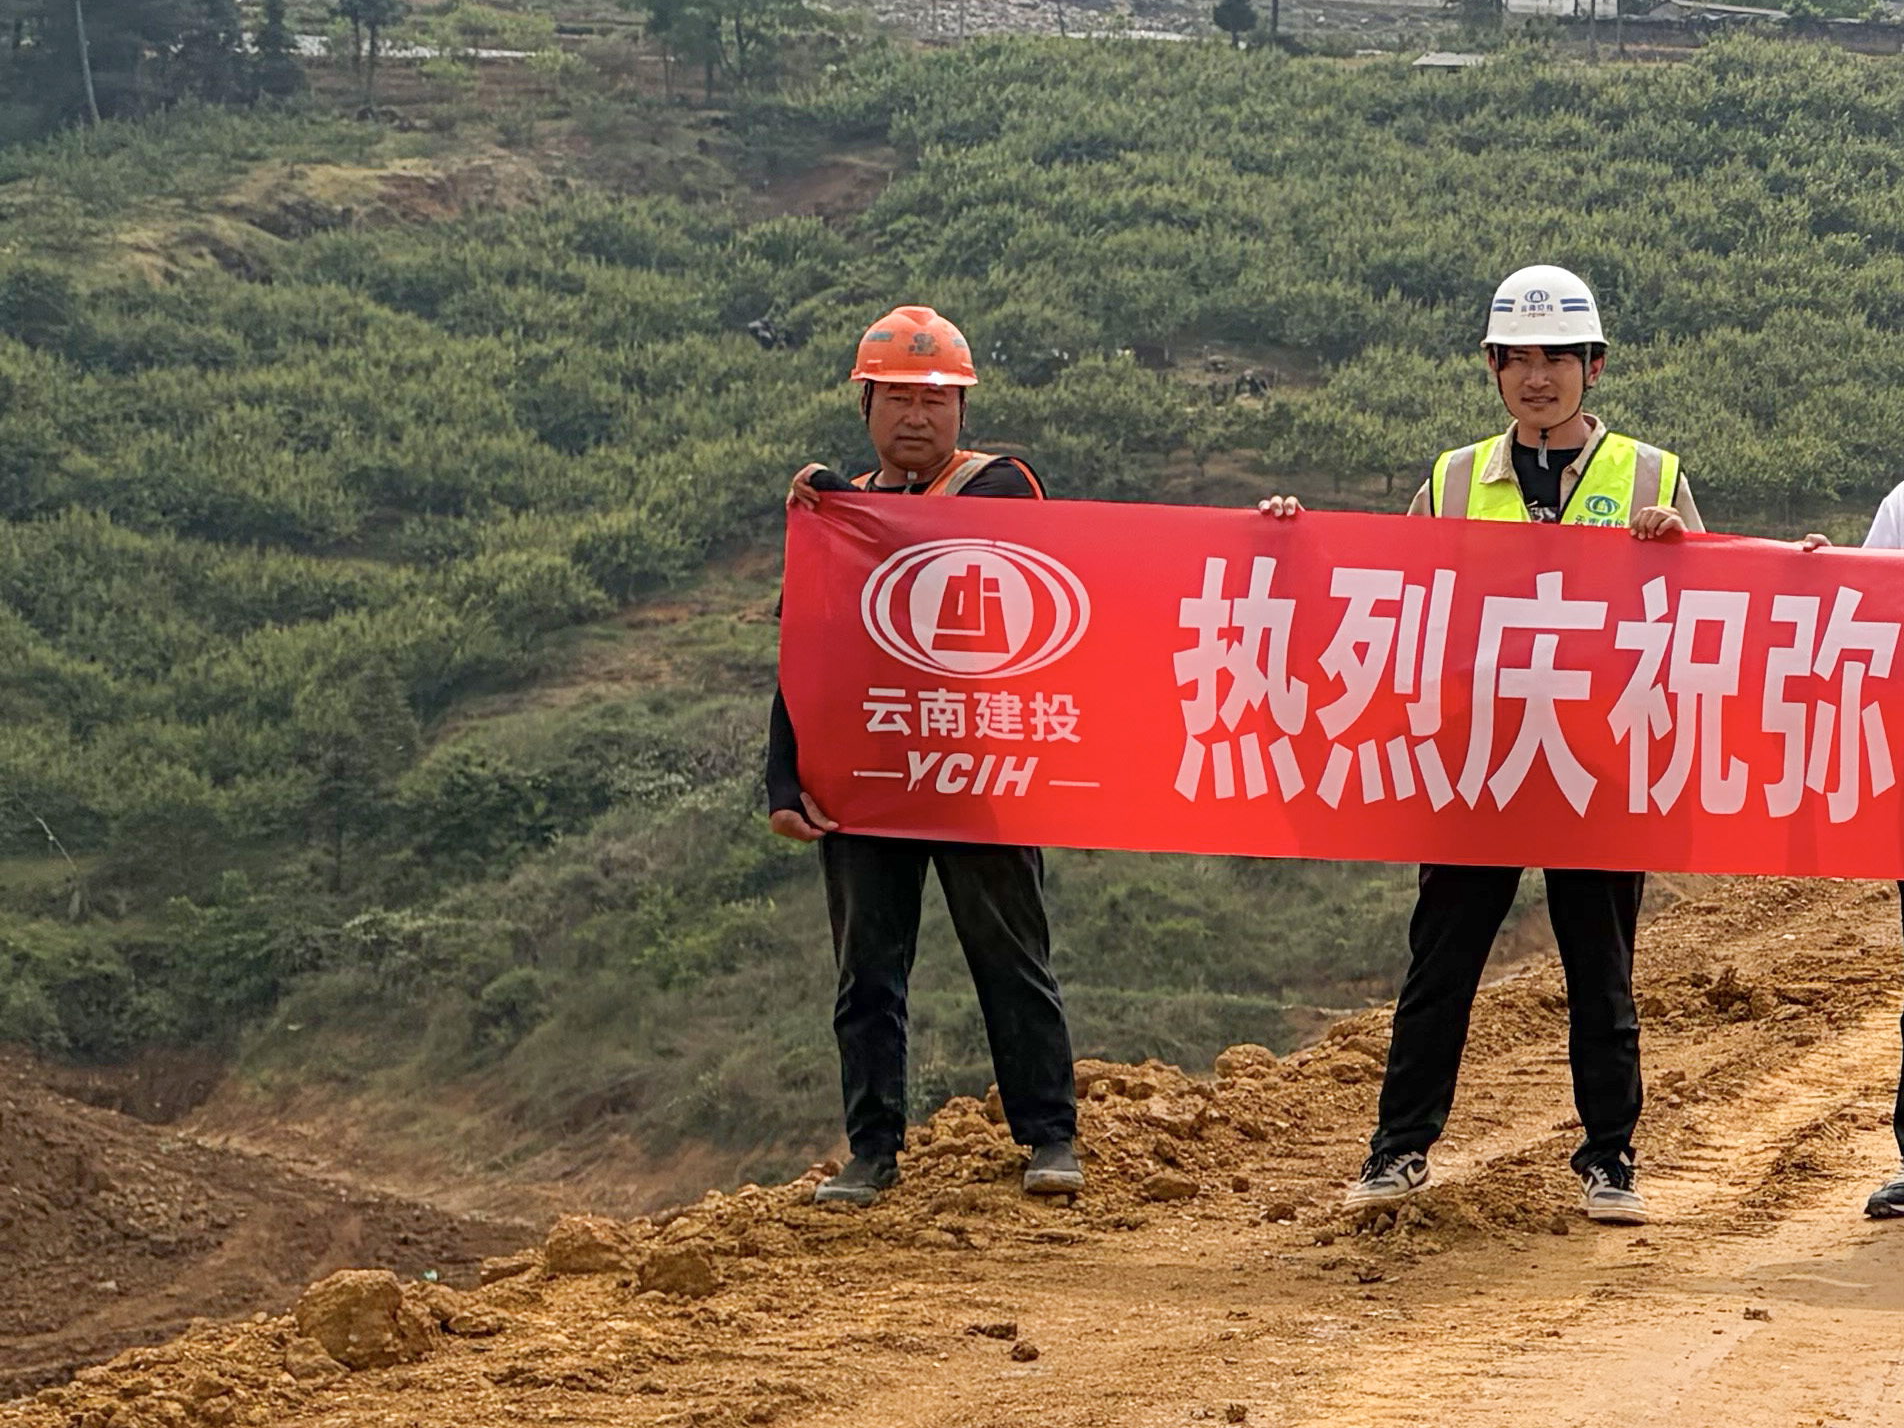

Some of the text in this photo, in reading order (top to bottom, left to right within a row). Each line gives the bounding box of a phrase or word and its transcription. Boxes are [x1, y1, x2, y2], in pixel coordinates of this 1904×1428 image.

[863, 687, 1082, 743] 云南建投
[906, 751, 1039, 797] YCIH
